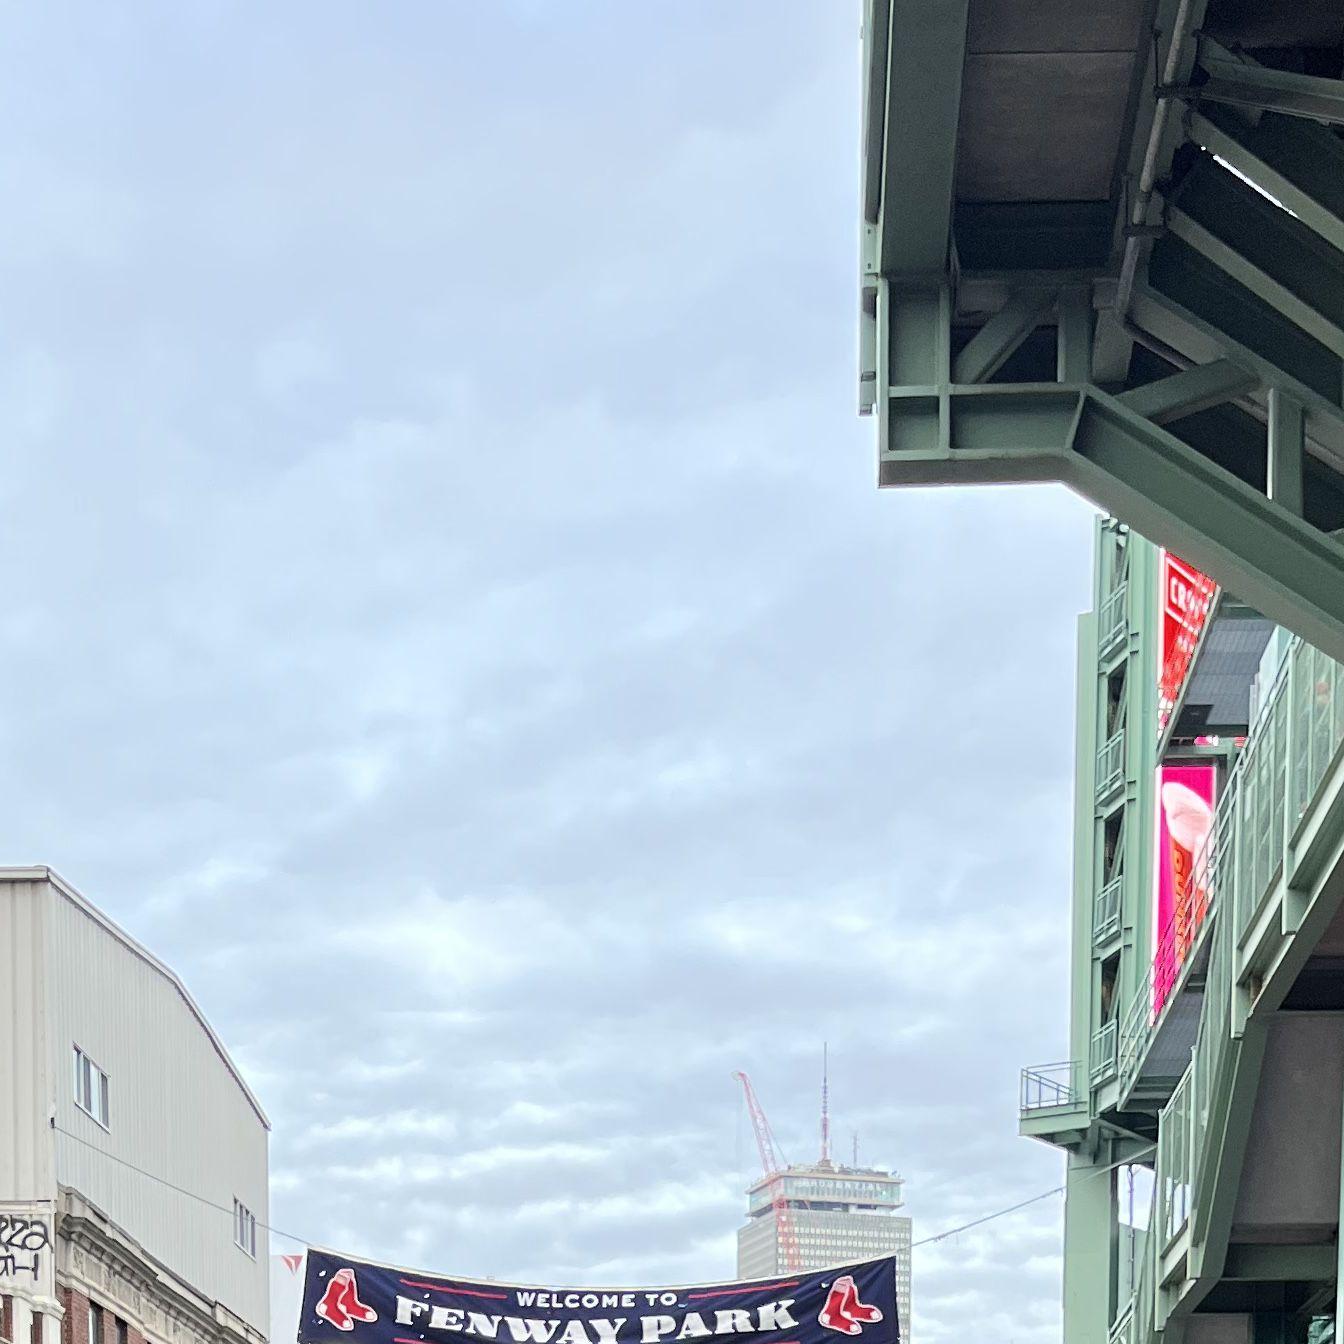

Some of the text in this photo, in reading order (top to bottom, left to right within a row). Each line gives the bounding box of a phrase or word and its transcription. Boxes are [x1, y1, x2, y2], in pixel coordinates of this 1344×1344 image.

[516, 1291, 678, 1308] WELCOME TO
[639, 1299, 799, 1344] PARK
